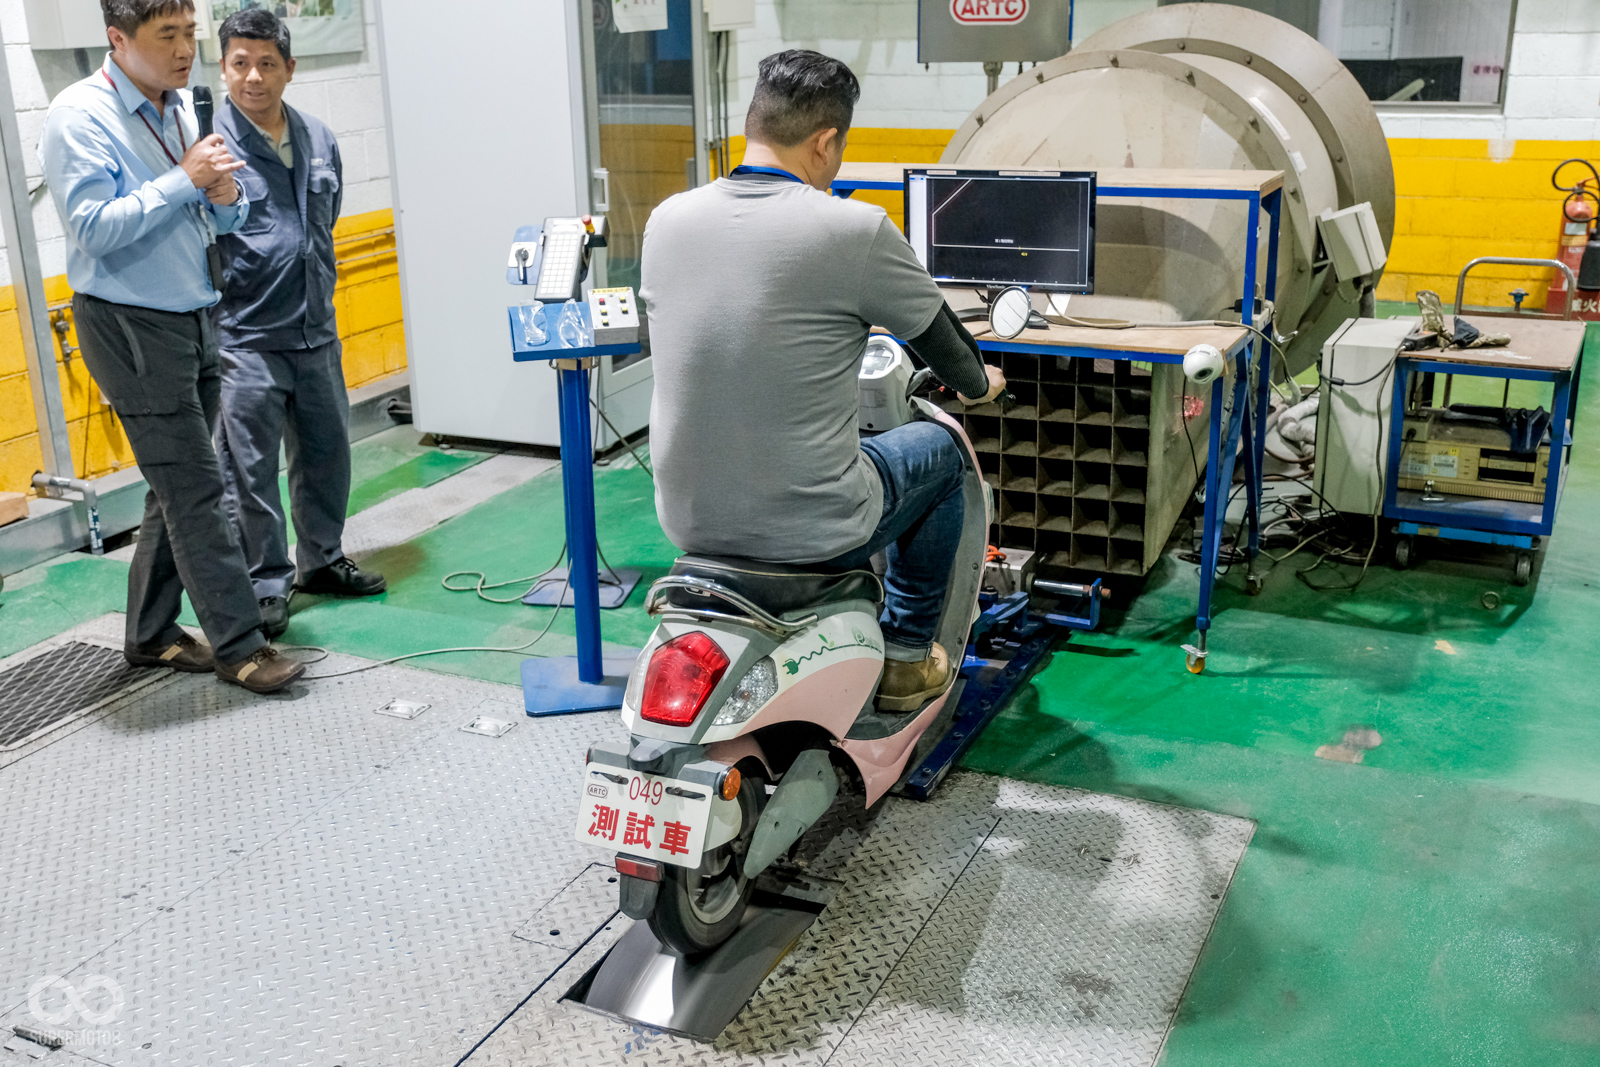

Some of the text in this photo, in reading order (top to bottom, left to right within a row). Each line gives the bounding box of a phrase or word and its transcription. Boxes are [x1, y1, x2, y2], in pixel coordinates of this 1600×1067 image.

[961, 0, 1018, 16] ARTC
[589, 786, 606, 796] ARTC
[629, 776, 663, 805] 049
[588, 804, 691, 855] 測試車
